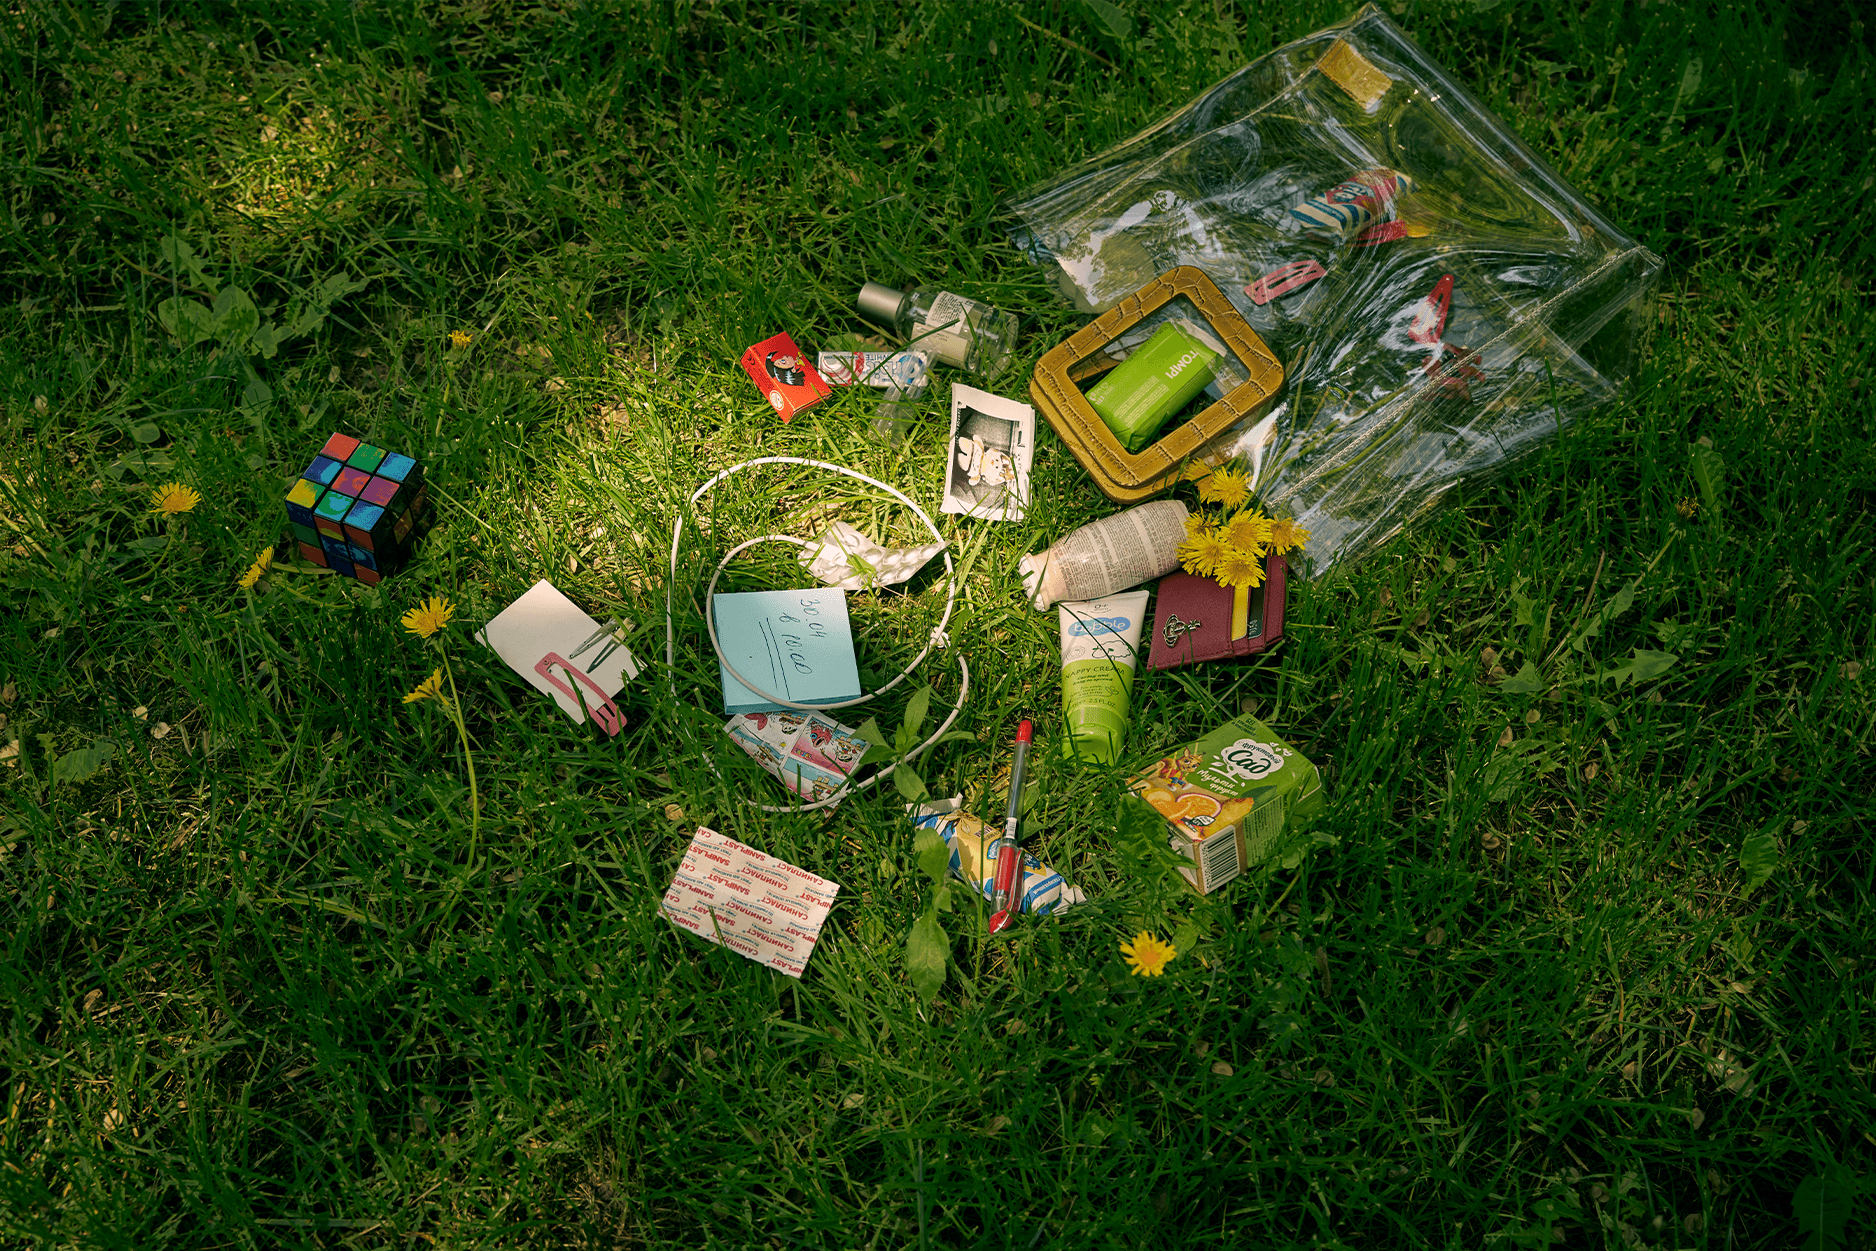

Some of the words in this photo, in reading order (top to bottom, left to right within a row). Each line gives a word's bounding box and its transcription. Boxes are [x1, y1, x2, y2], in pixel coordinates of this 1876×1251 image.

[1165, 350, 1198, 379] TOMPI
[800, 599, 828, 638] 30.04
[1227, 749, 1271, 774] Сад
[1241, 742, 1282, 765] фруктовый
[1196, 769, 1235, 790] Мульти
[1209, 782, 1239, 797] фрукт
[723, 839, 765, 860] SANIPLAST
[707, 873, 749, 894] SANIPLAST
[740, 866, 787, 890] САНИПЛАСТ
[776, 862, 823, 885] САНИПЛАСТ
[726, 900, 772, 924] САНИПЛАСТ
[761, 896, 808, 920] САНИПЛАСТ
[746, 928, 793, 952] САНИПЛАСТ
